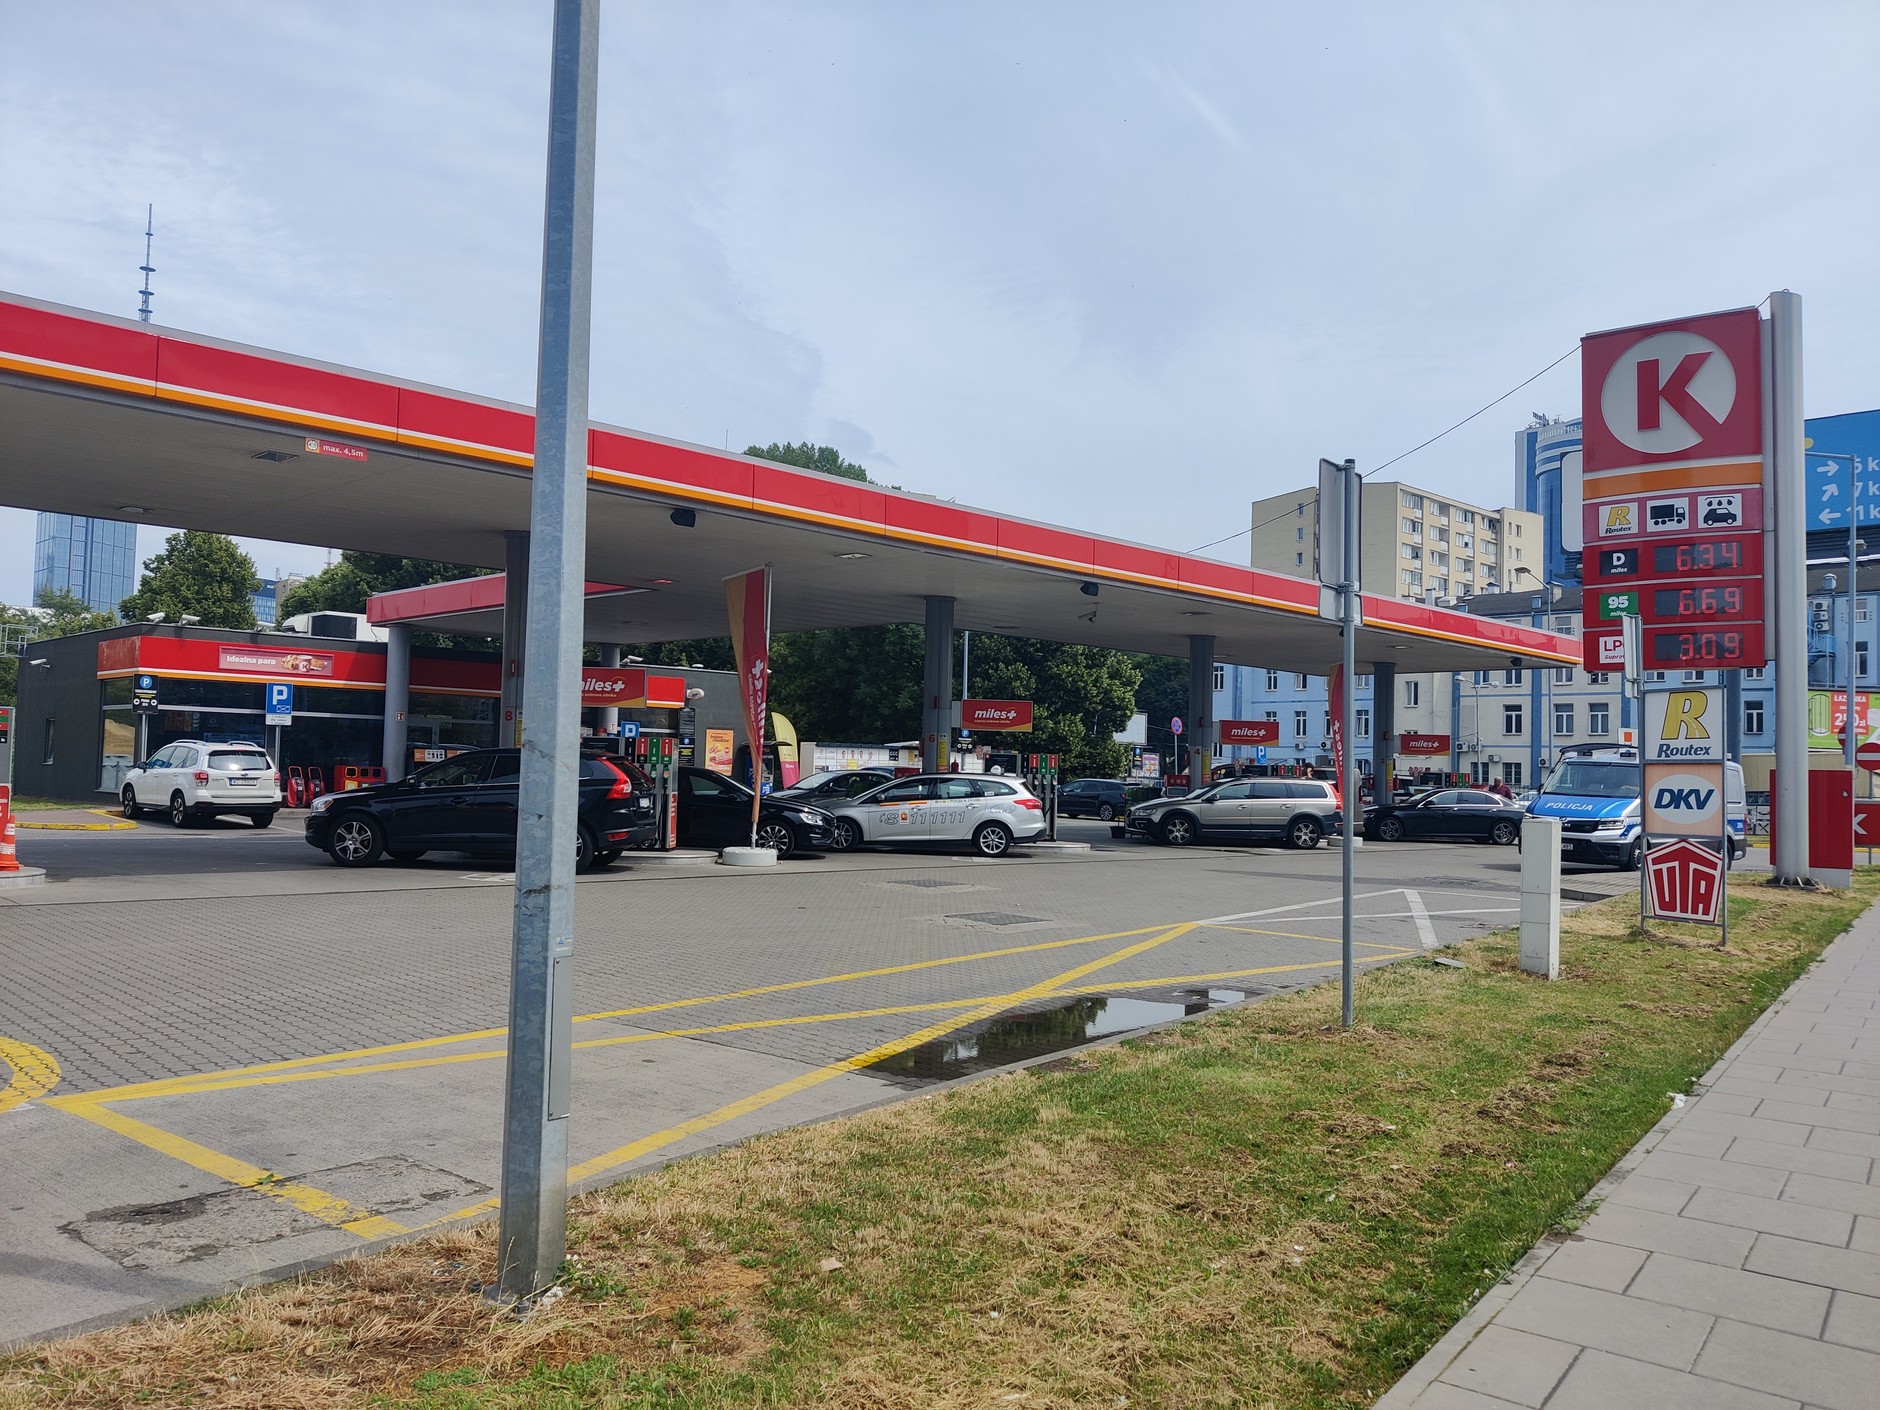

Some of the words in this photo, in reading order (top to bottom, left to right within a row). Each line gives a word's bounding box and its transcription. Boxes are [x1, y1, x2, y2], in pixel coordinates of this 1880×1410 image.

[1636, 351, 1722, 441] K
[323, 445, 342, 453] max.
[344, 448, 364, 457] 4,5m
[1605, 526, 1632, 535] Routex
[1613, 553, 1625, 565] D
[1676, 542, 1737, 571] 6.34
[1608, 596, 1629, 608] 95
[1679, 587, 1740, 615] 6.69
[1604, 640, 1624, 651] LP
[1679, 632, 1740, 660] 3.09
[227, 655, 257, 664] Idealna
[258, 657, 276, 666] para
[273, 686, 287, 705] P
[505, 710, 513, 721] 8
[974, 709, 1017, 719] miles+
[1231, 728, 1266, 736] miles+
[1657, 743, 1712, 758] Routex
[1545, 803, 1593, 811] POLICJA
[1654, 789, 1715, 810] DKV
[1652, 846, 1718, 916] UTA
